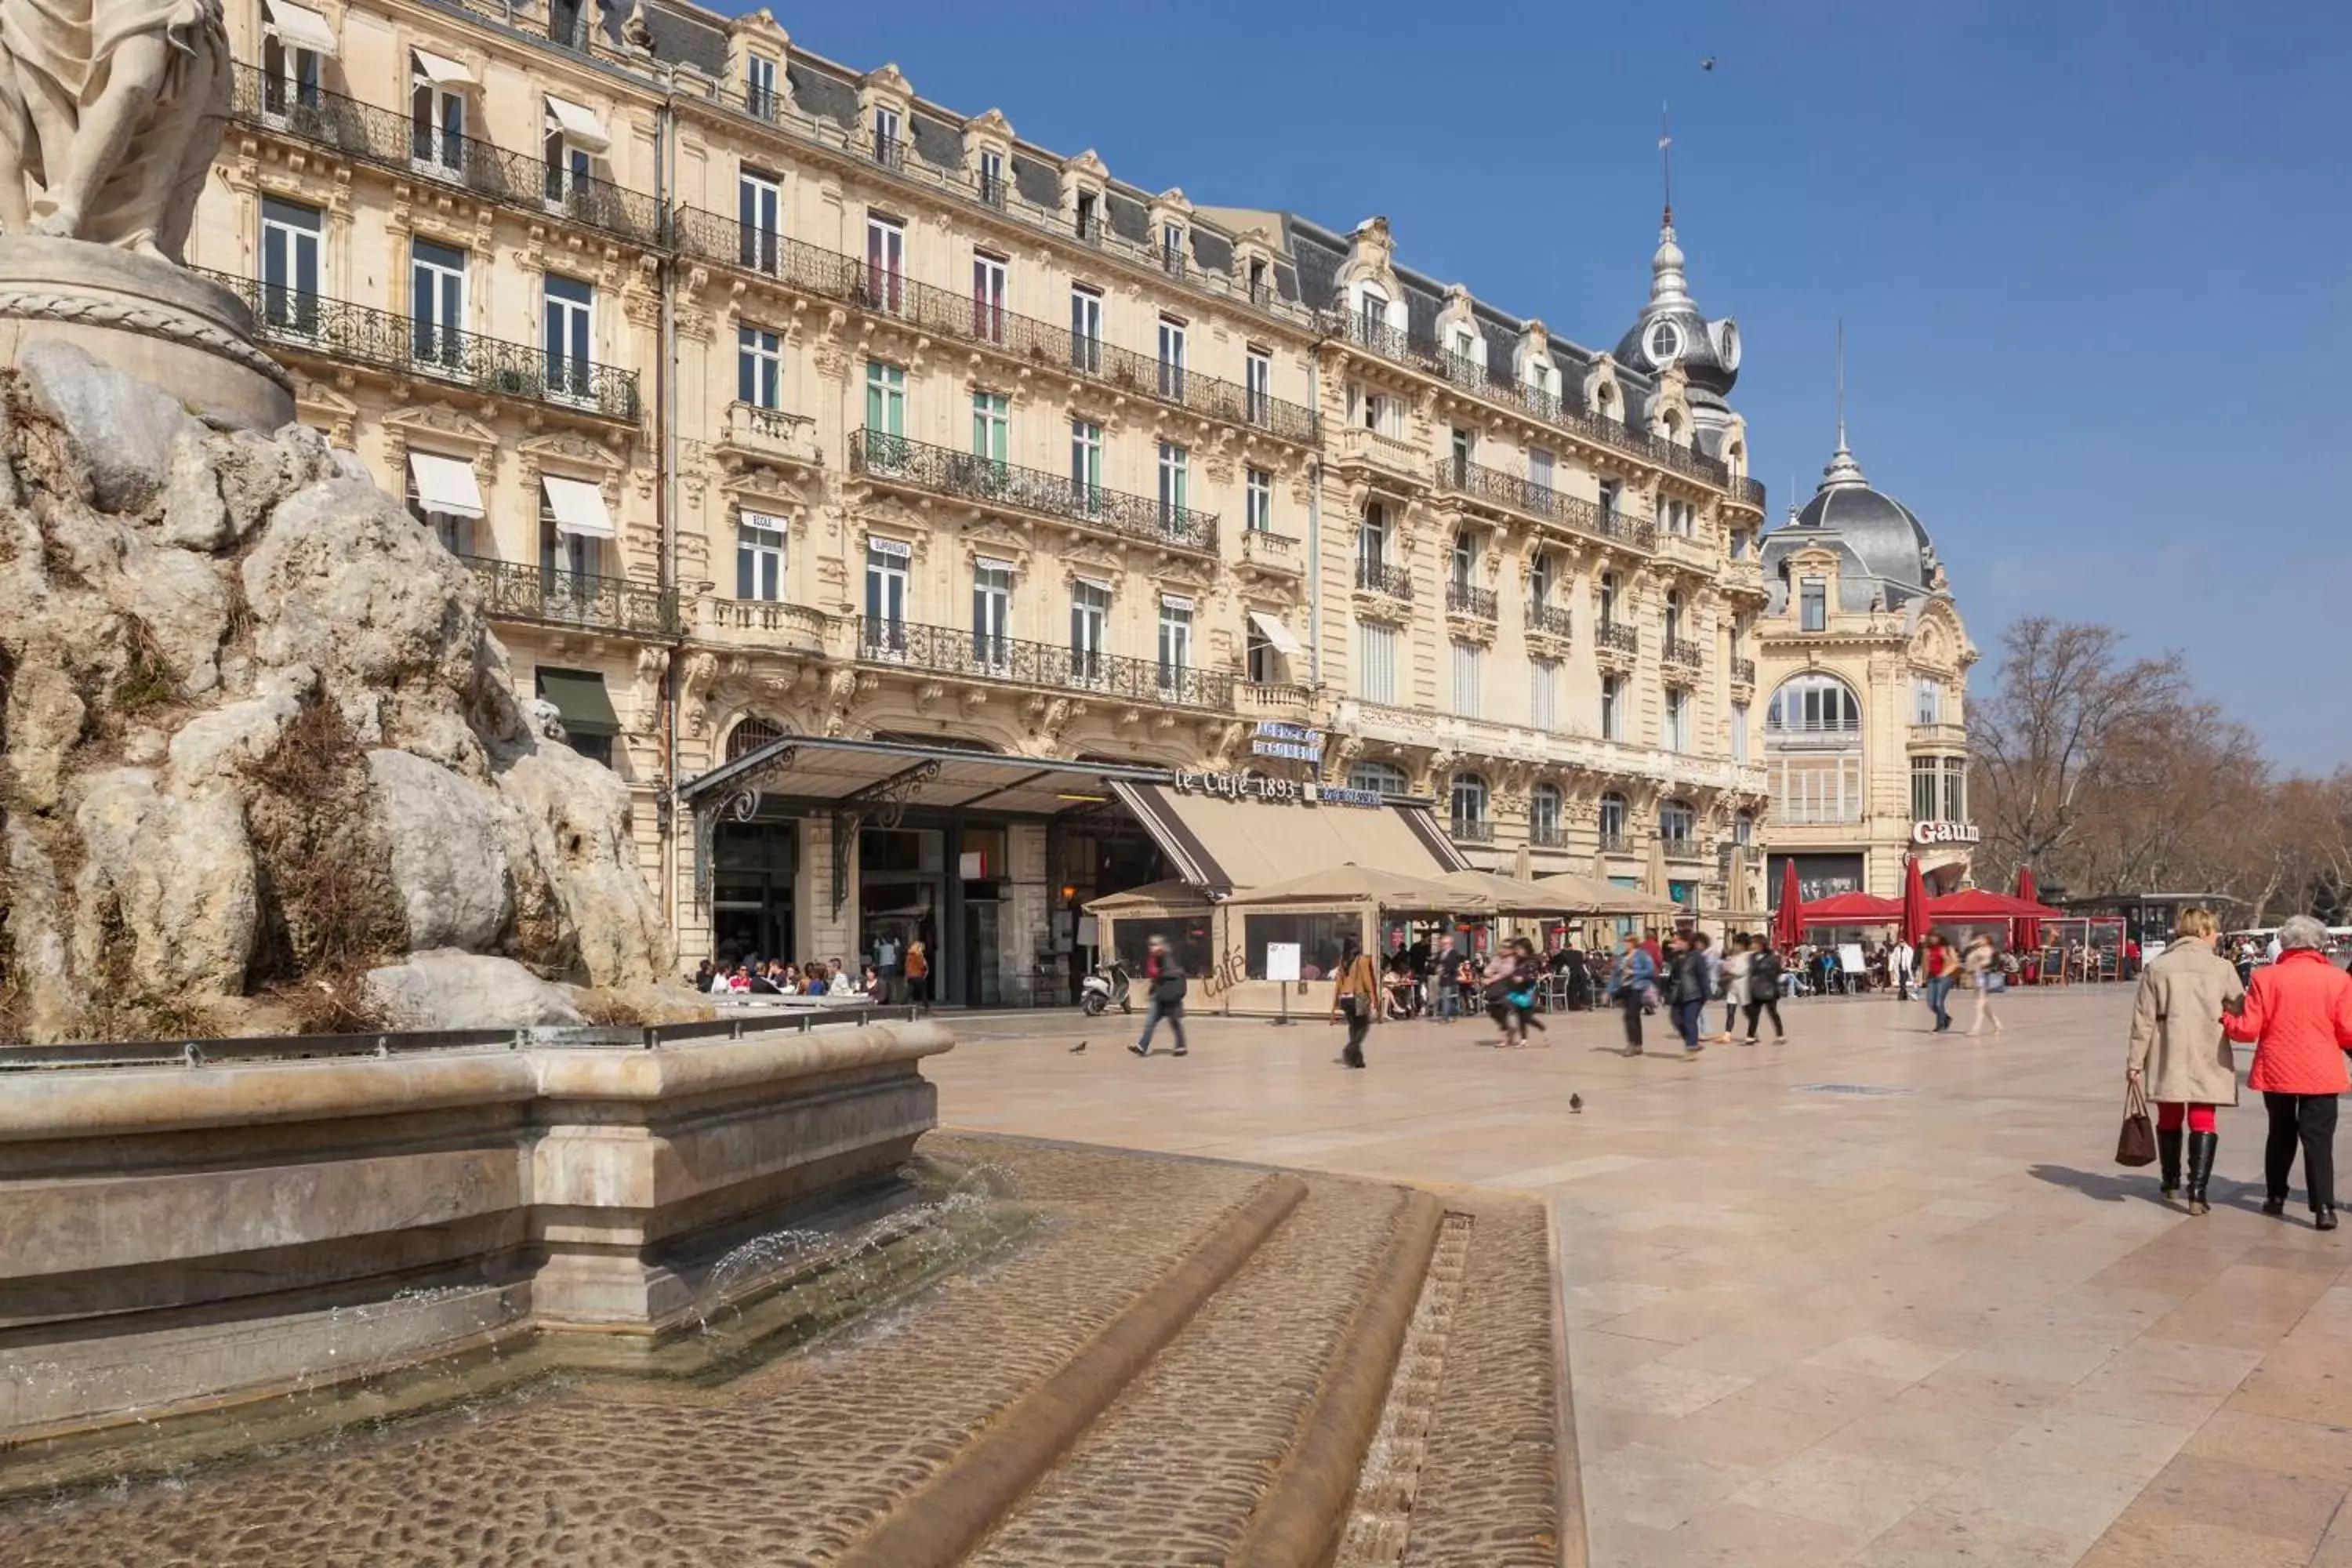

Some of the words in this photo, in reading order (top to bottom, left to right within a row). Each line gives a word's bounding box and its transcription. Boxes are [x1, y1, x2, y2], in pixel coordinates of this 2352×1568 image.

[1175, 768, 1192, 789] le
[1203, 768, 1250, 798] Café
[1258, 776, 1294, 799] 1893
